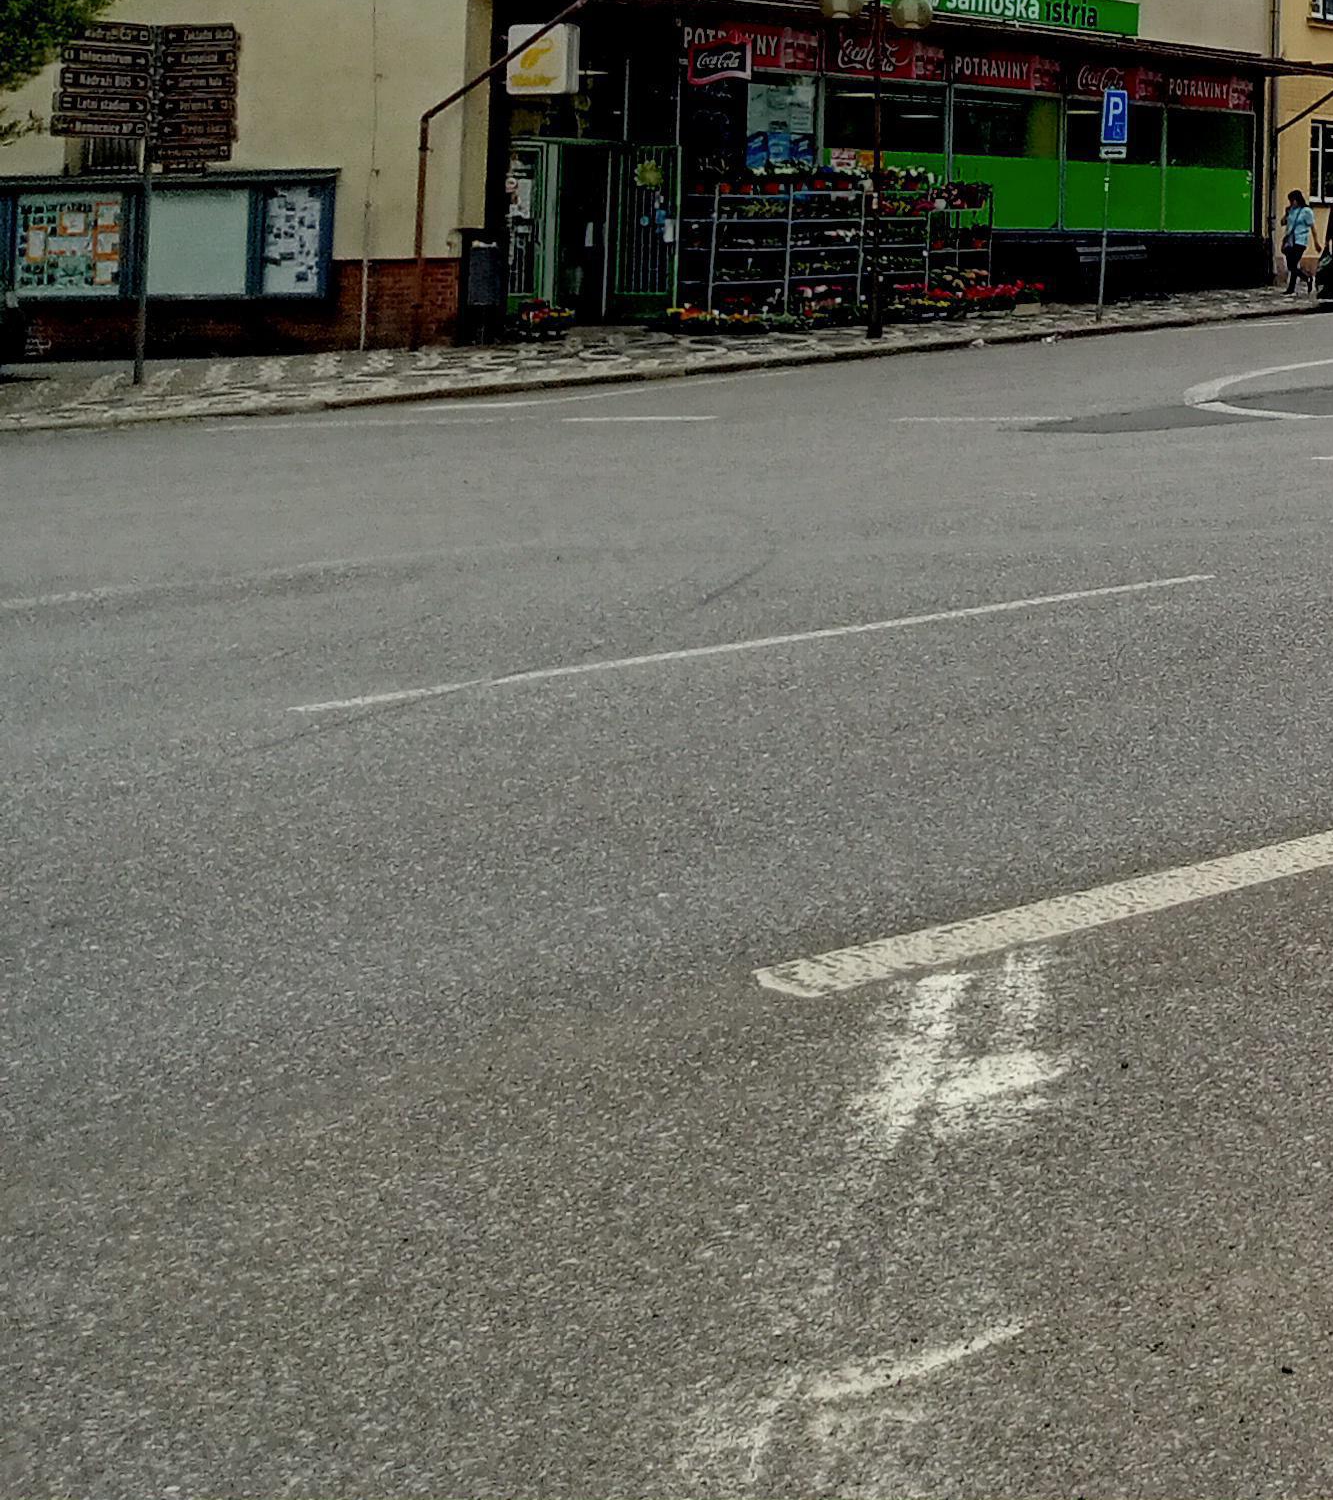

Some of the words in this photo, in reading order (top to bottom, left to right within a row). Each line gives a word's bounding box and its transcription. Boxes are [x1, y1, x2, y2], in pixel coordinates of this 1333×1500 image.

[954, 56, 1029, 80] POTRAVINY
[115, 75, 132, 87] BUS
[1169, 78, 1230, 100] POTRAVINY
[1107, 96, 1124, 127] P
